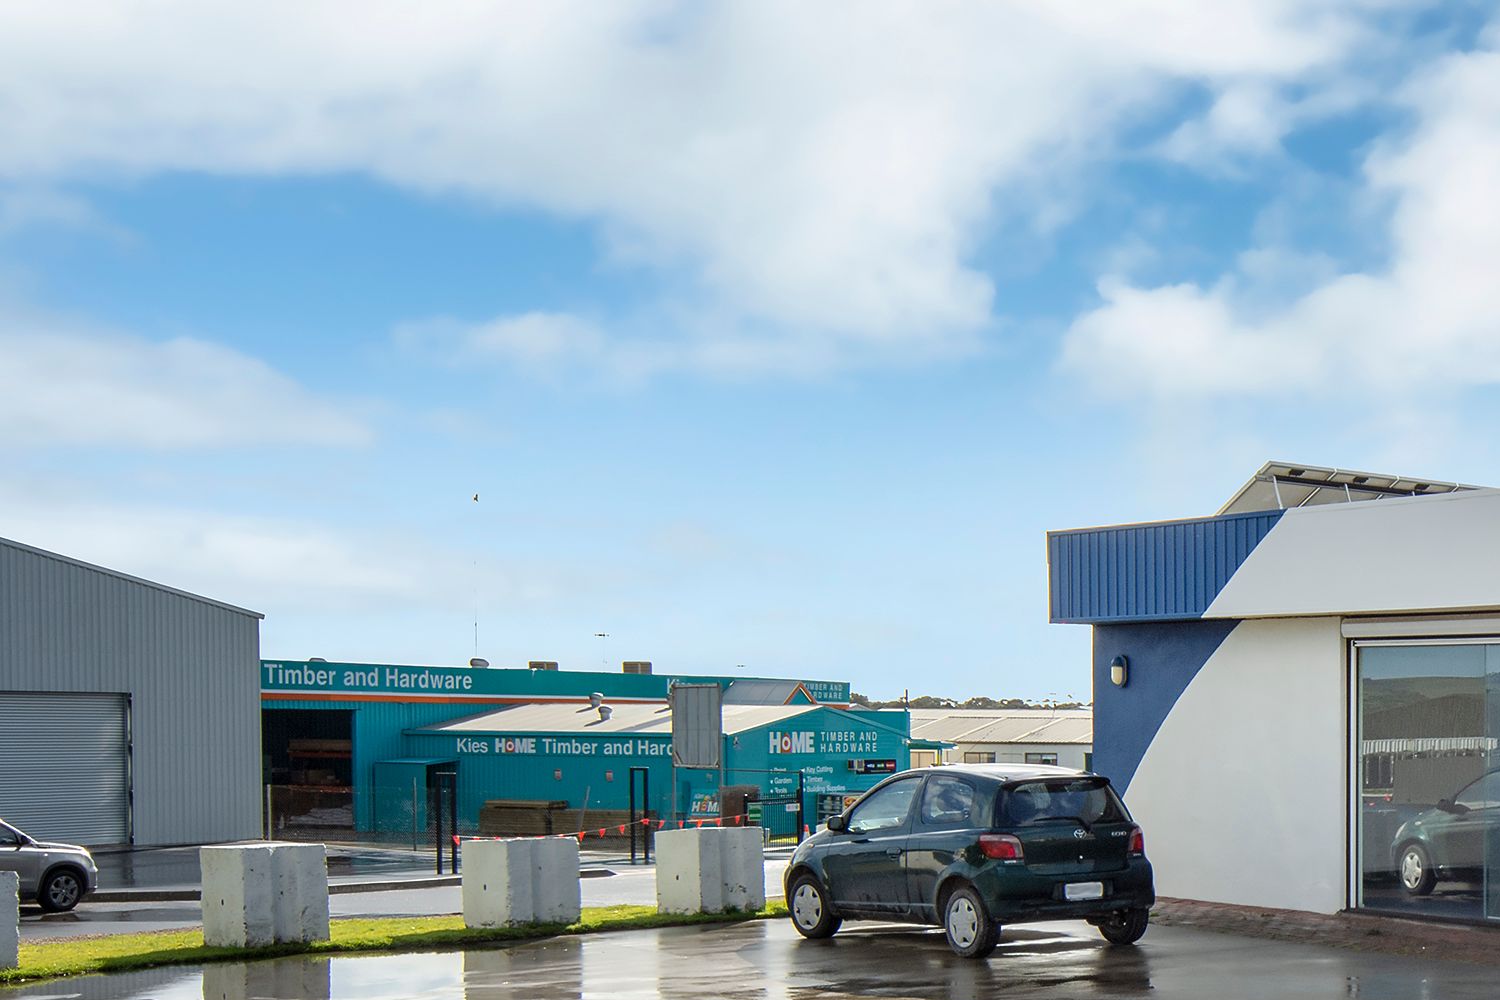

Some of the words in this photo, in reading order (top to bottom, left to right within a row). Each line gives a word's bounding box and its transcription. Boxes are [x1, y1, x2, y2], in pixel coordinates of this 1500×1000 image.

[264, 664, 336, 685] Timber
[343, 668, 379, 687] and
[385, 668, 473, 690] Hardware
[820, 731, 855, 741] TIMBER
[860, 732, 878, 741] AND
[456, 738, 488, 753] Kies
[495, 738, 536, 753] HOME
[542, 738, 598, 755] Timber
[603, 739, 633, 755] and
[769, 731, 815, 753] HOME
[820, 742, 877, 752] HARDWARE
[816, 766, 833, 774] Cutting
[826, 785, 846, 793] Supplies
[691, 801, 720, 812] HOM
